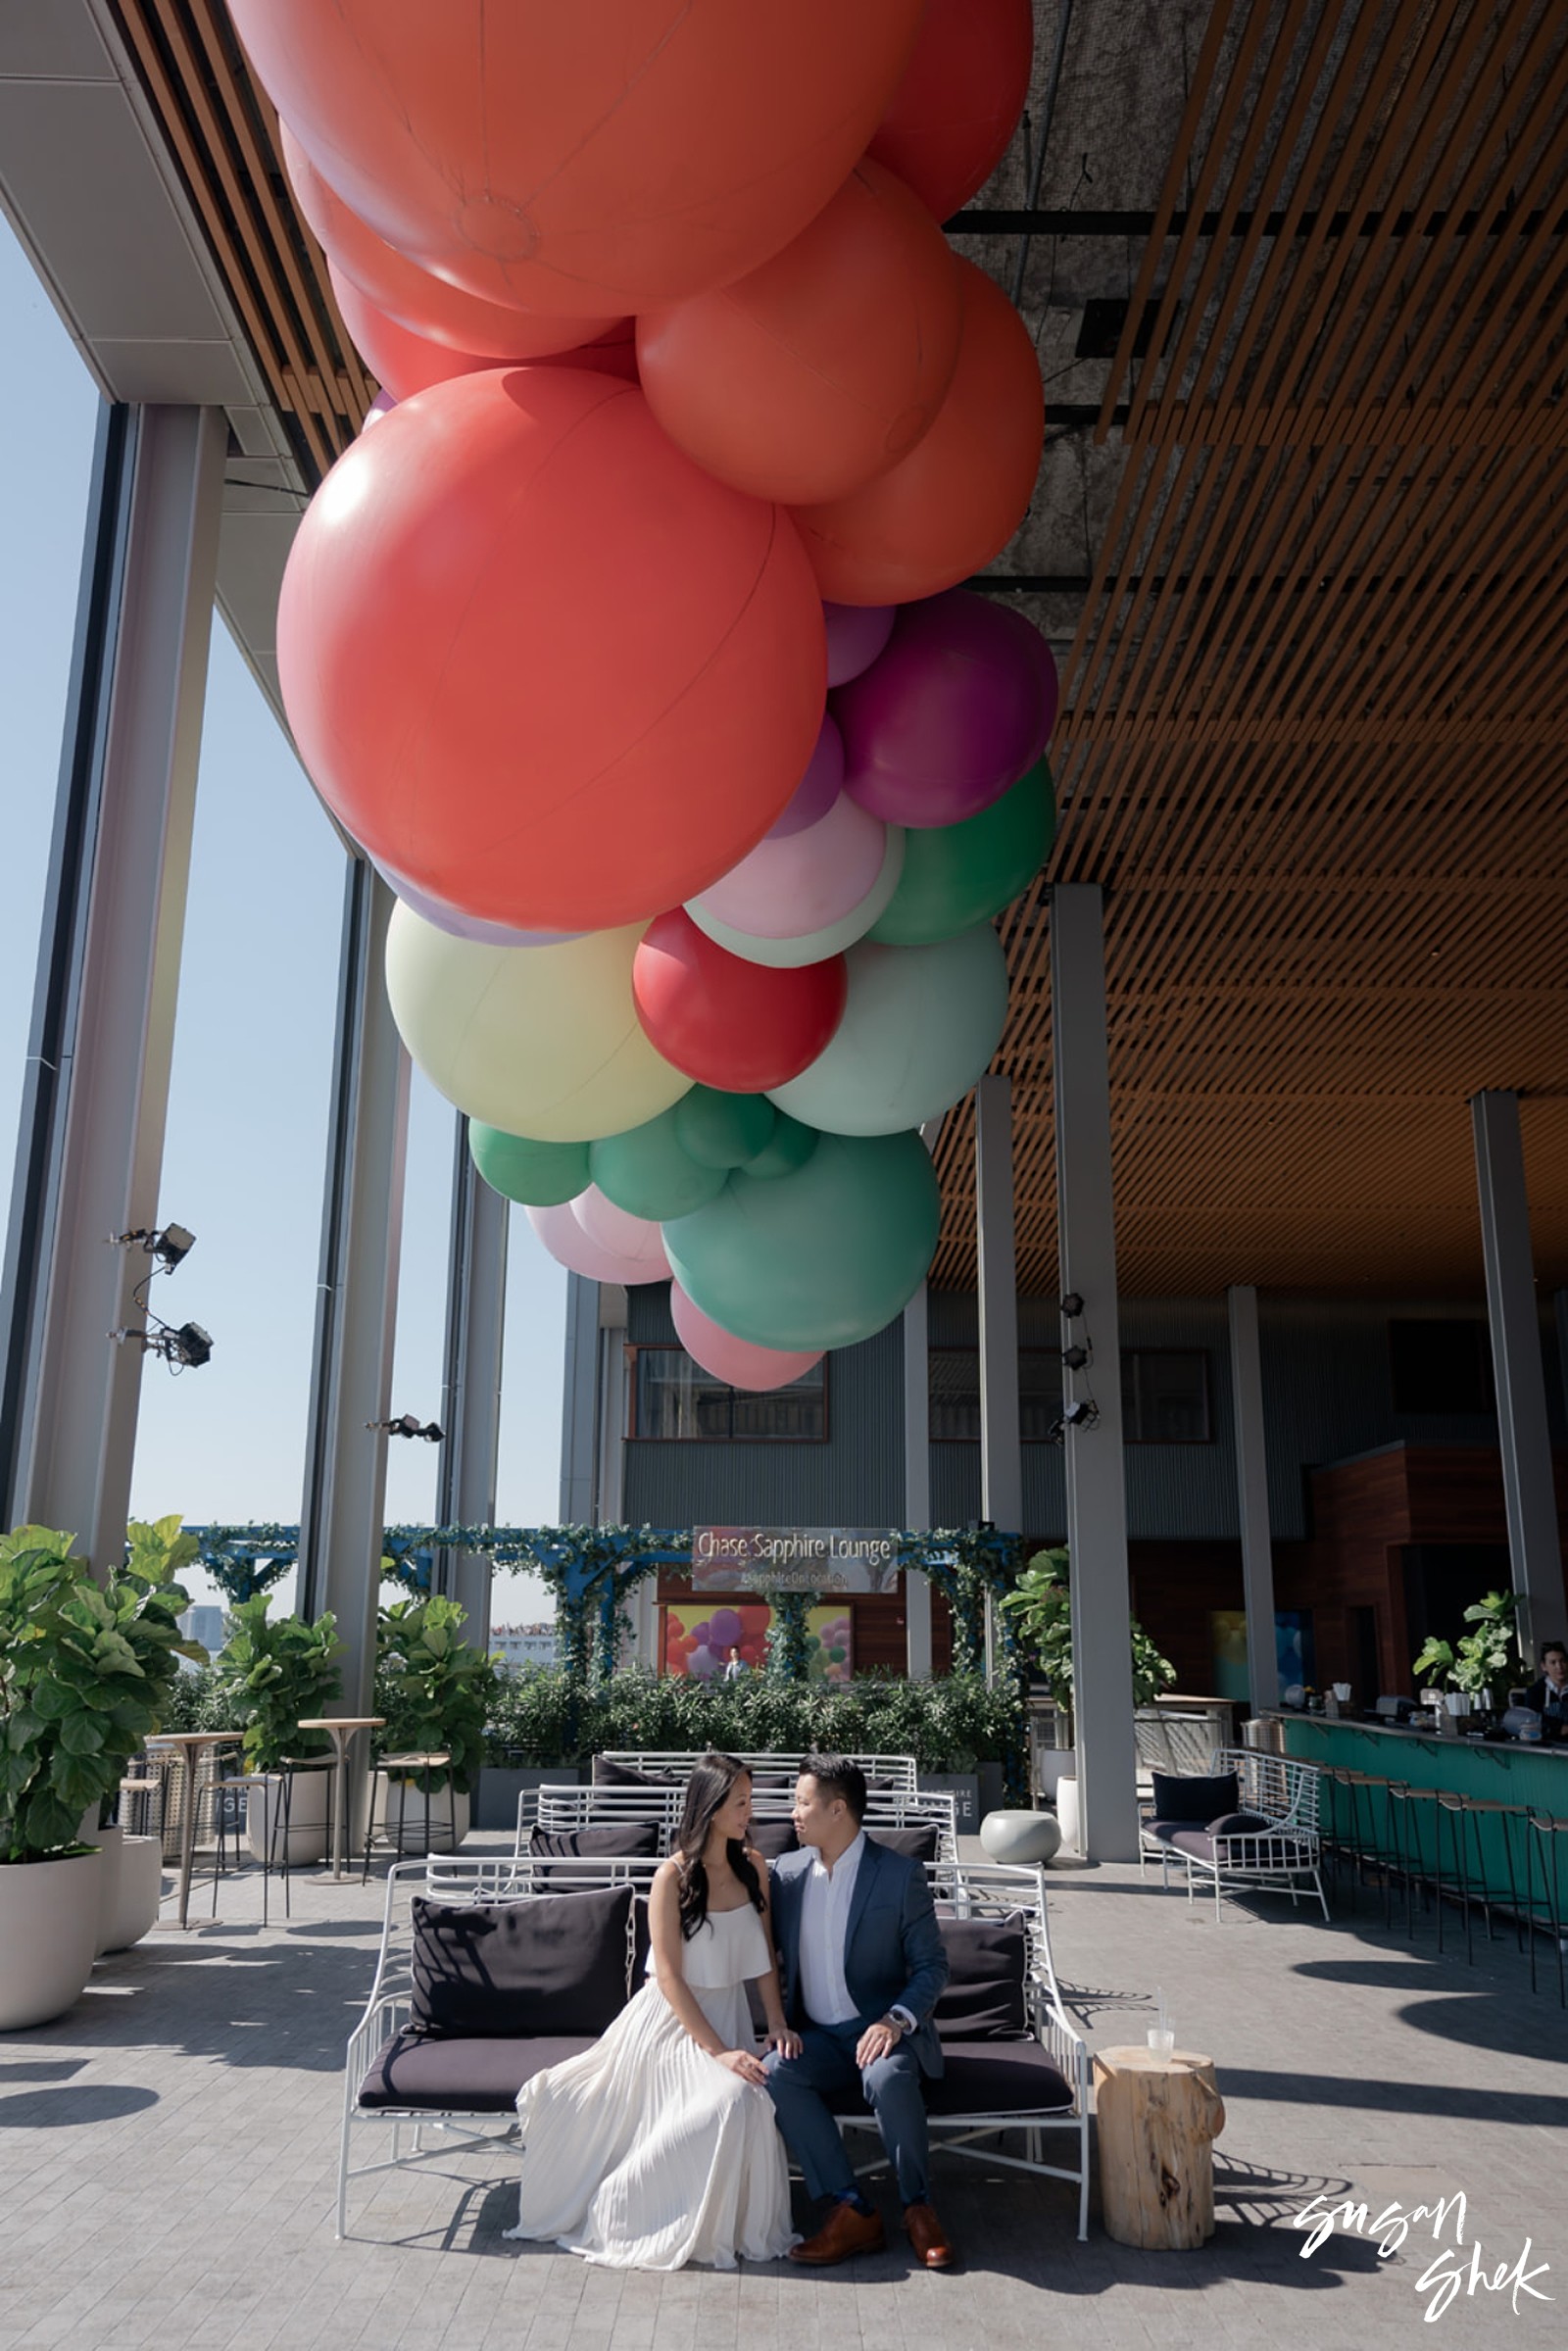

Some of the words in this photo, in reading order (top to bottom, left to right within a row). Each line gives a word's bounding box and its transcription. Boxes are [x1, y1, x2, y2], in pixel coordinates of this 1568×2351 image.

[699, 1532, 748, 1558] Chase
[755, 1533, 824, 1564] Sapphire
[830, 1535, 891, 1566] Lounge
